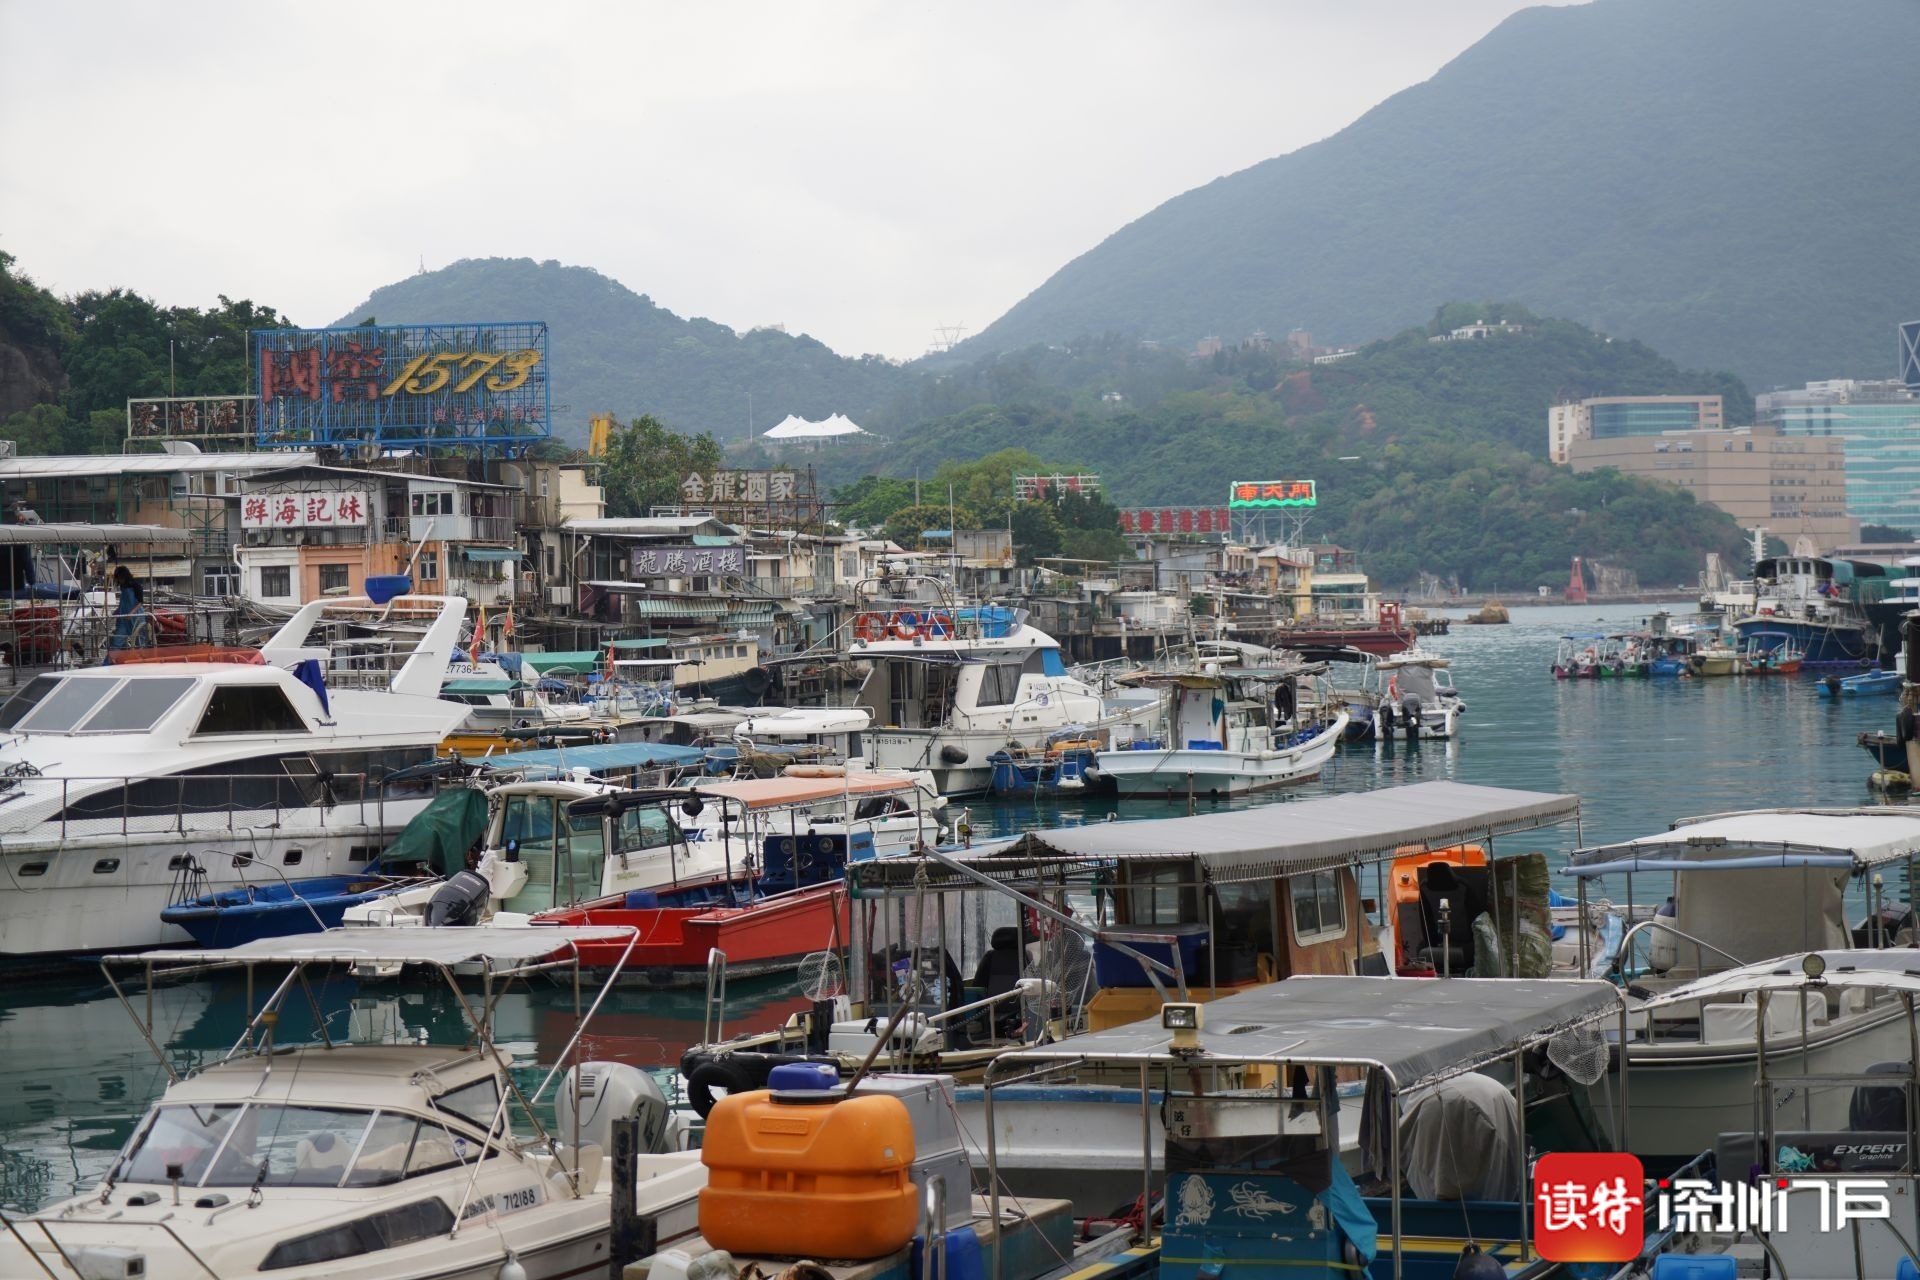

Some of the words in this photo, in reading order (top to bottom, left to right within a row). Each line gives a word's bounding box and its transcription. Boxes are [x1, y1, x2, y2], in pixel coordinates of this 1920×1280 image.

[681, 471, 795, 502] 金龍酒家
[636, 549, 741, 574] 龍騰酒樓
[1833, 1143, 1907, 1155] EXPERT
[1859, 1153, 1894, 1161] Graphite
[503, 1188, 536, 1211] 712188
